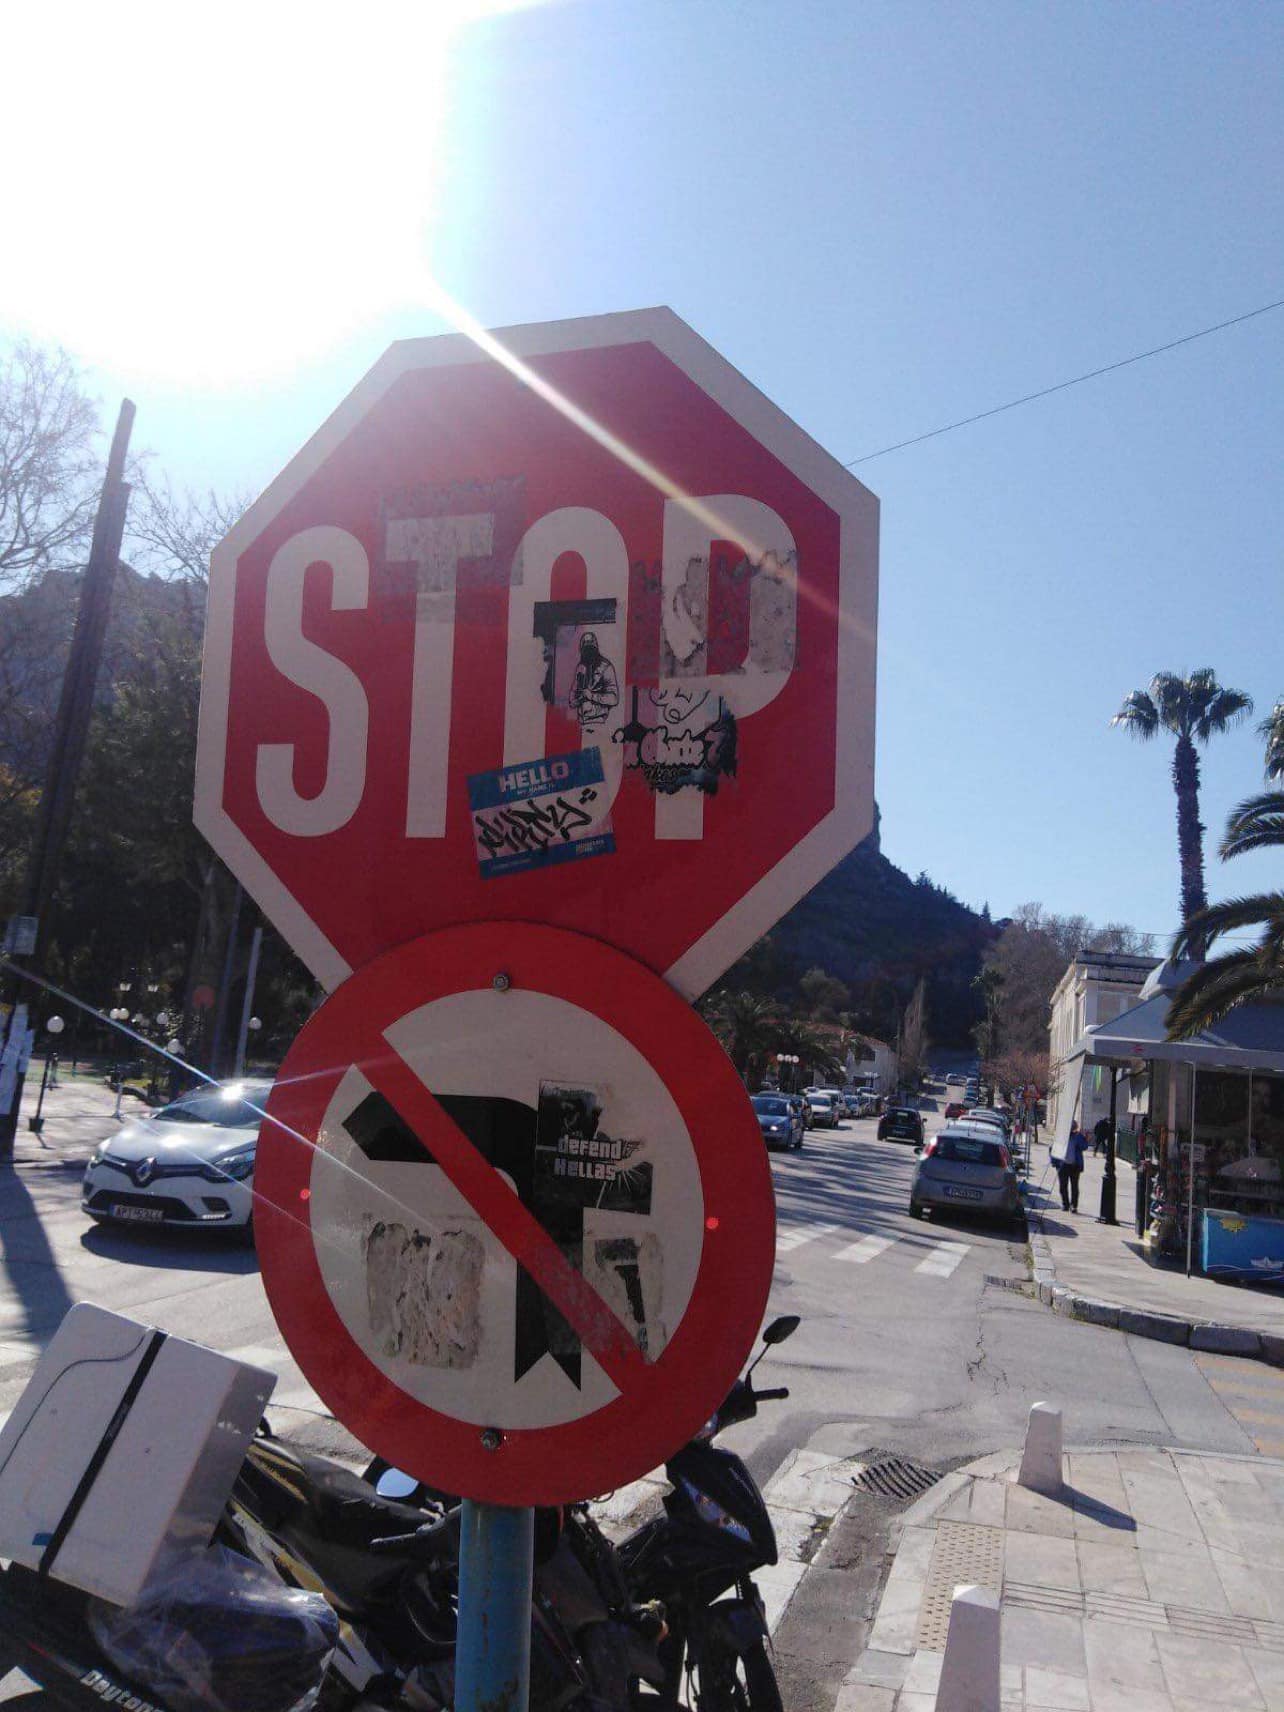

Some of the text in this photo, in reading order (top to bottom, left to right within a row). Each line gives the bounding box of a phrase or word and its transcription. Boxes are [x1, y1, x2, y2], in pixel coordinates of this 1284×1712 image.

[256, 494, 798, 841] STOP
[498, 761, 570, 792] HELLO
[557, 1134, 623, 1159] defend
